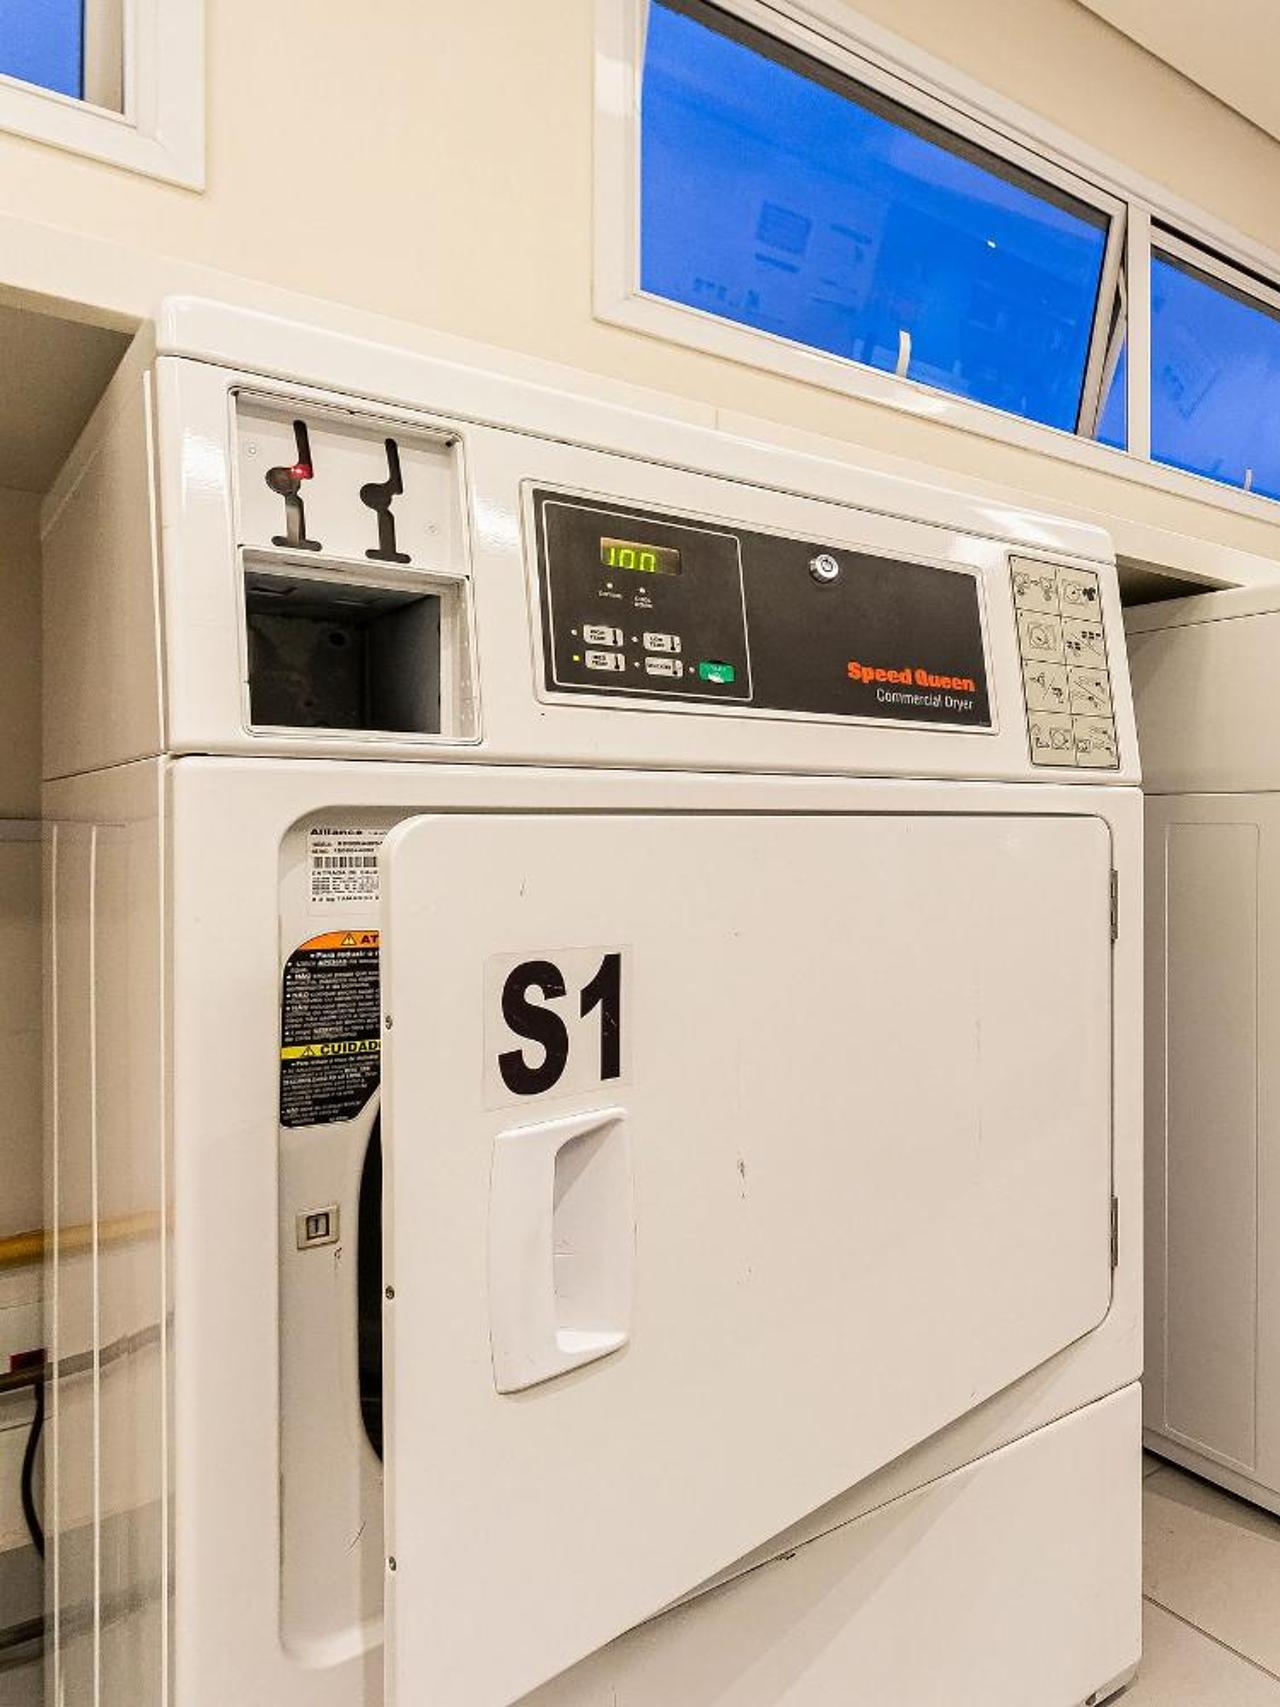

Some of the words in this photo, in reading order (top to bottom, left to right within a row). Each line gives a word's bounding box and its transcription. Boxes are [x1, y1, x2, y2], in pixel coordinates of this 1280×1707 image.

[847, 661, 912, 685] Speed
[914, 668, 976, 692] Queen
[876, 688, 942, 708] Commercial
[944, 695, 973, 711] Dryer
[310, 828, 363, 836] Alliance
[498, 953, 621, 1096] S1
[320, 1041, 381, 1054] CUIDAD
